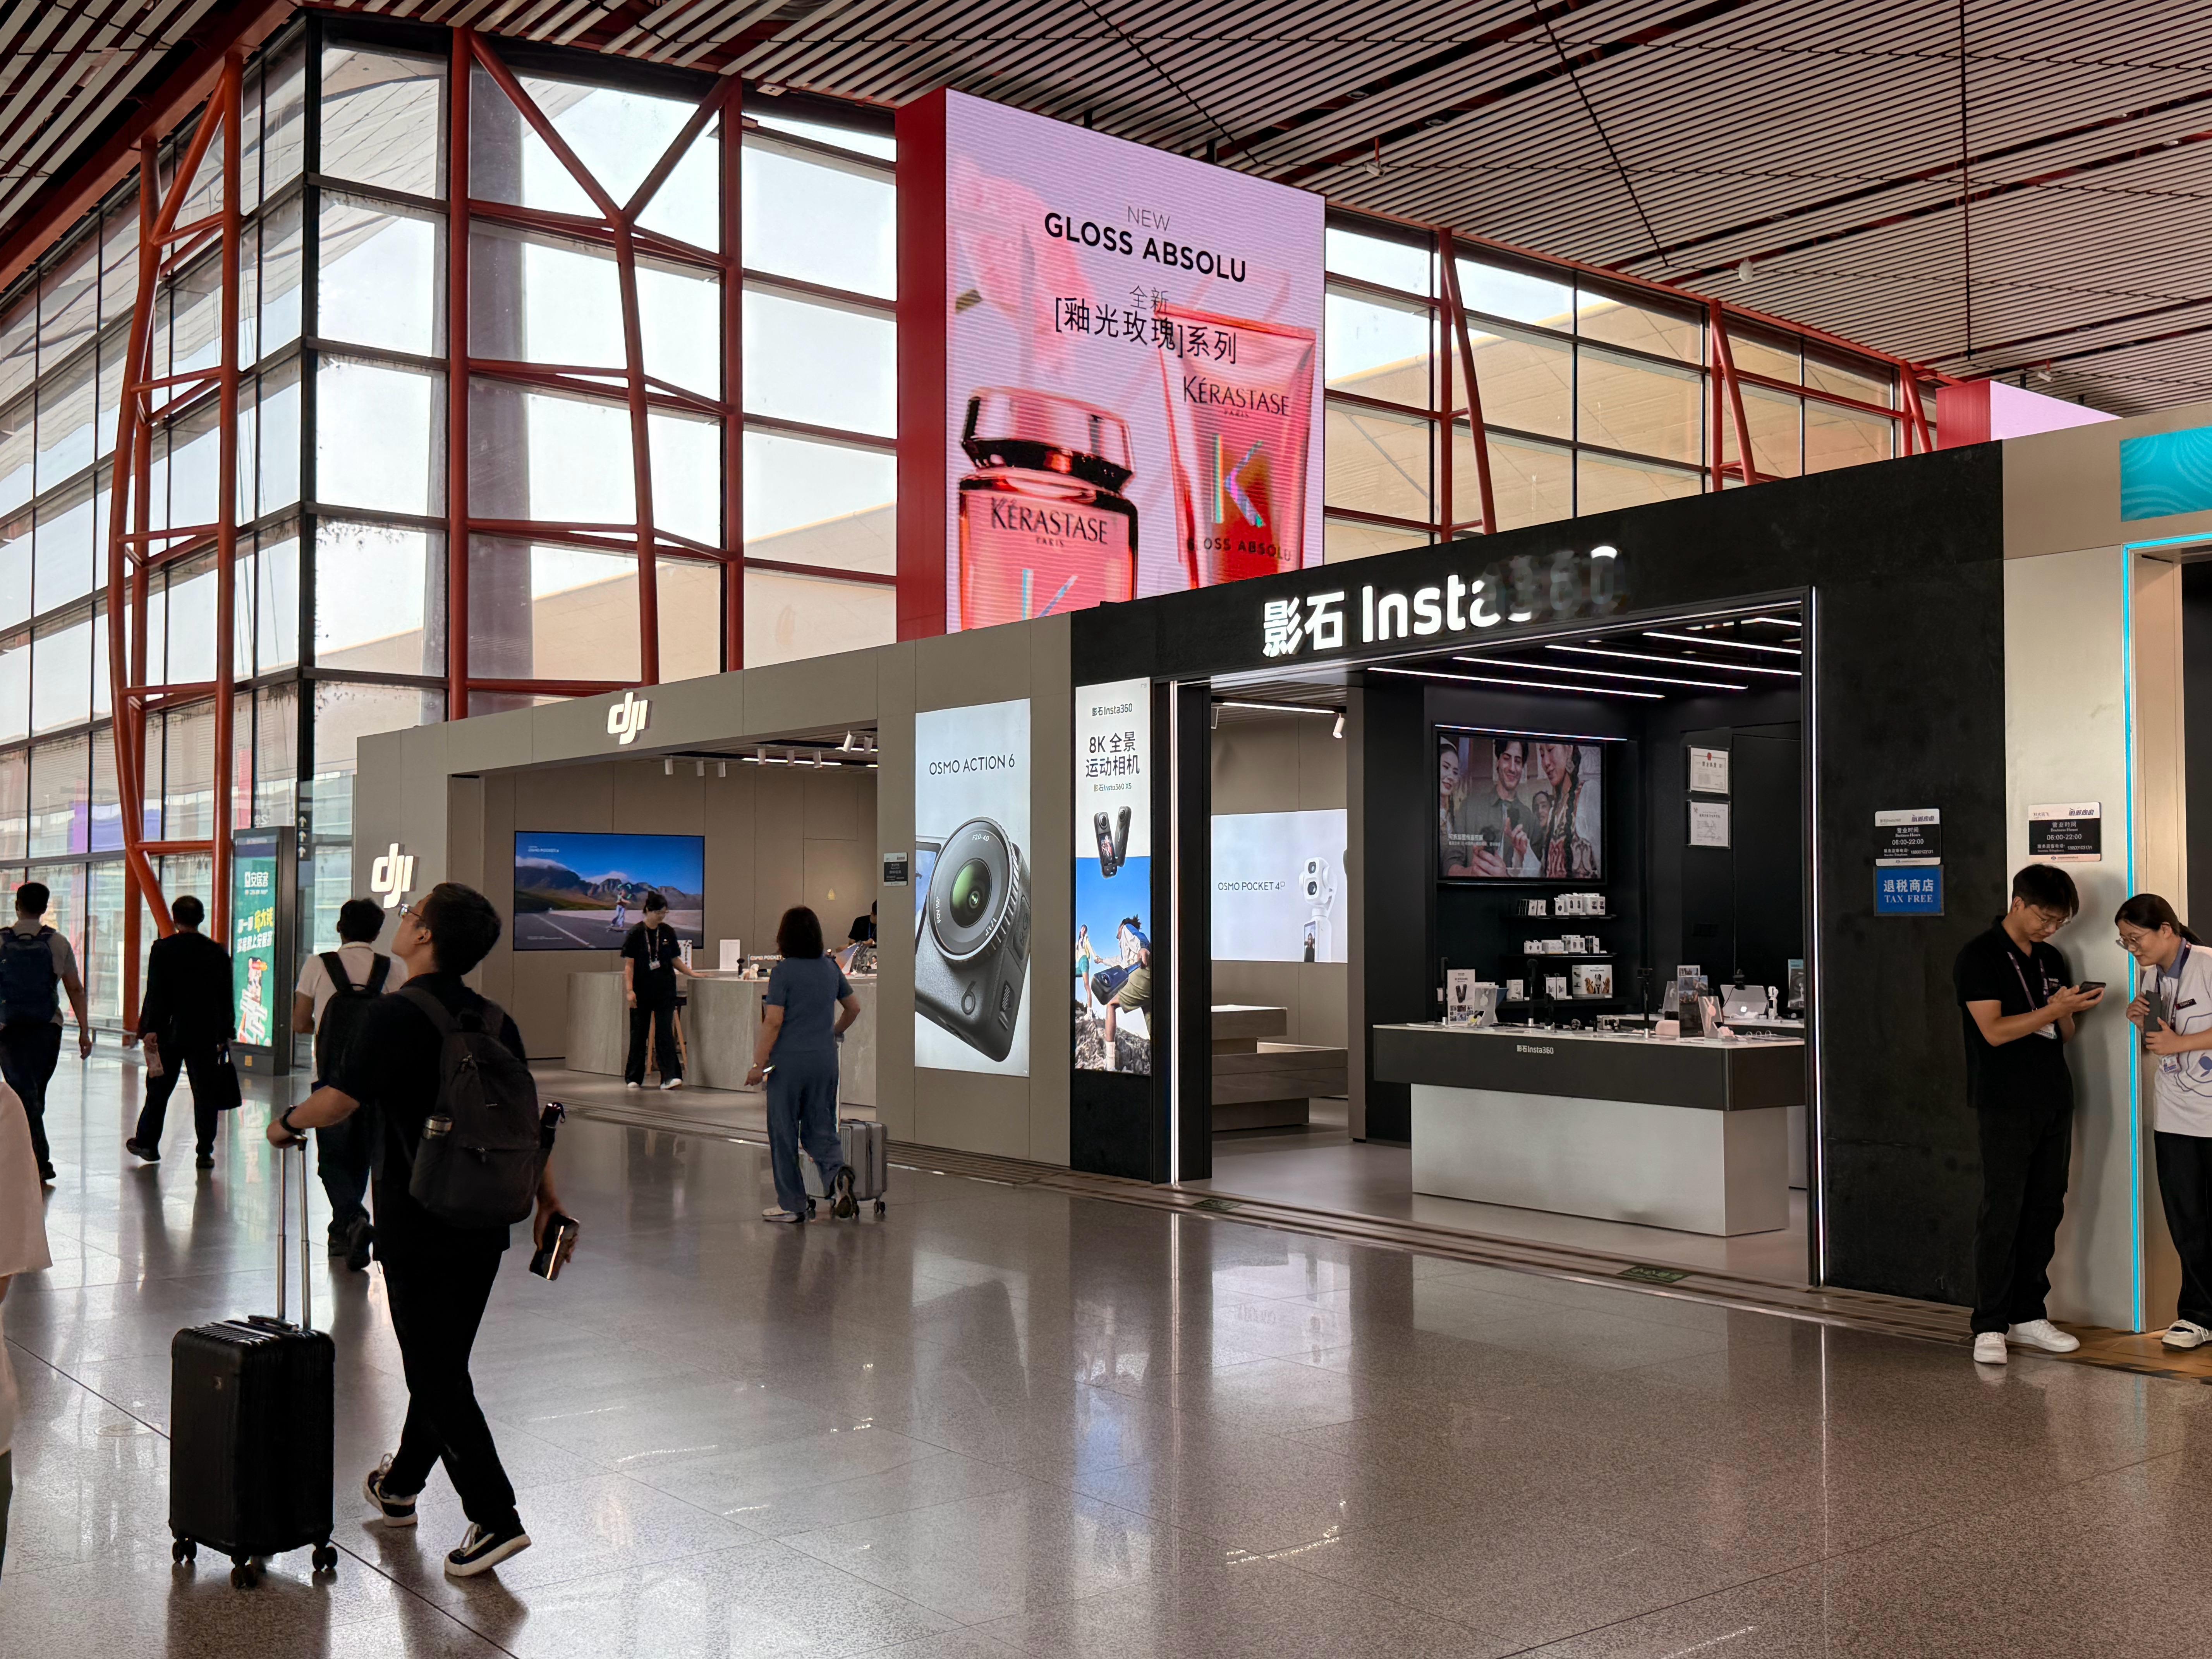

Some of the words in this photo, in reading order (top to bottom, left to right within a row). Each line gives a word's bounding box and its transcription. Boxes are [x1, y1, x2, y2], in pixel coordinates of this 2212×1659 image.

[1127, 206, 1170, 232] NEW
[1044, 212, 1133, 255] GLOSS
[1142, 237, 1246, 282] ABSOLU
[1129, 285, 1169, 312] 全新
[1056, 297, 1237, 364] [釉光玫瑰]系列
[1183, 375, 1291, 417] KÉRASTASE
[991, 497, 1108, 545] KÉRASTASE
[1036, 536, 1064, 547] PARIS
[1237, 541, 1291, 562] ABSOLU
[1262, 595, 1346, 658] 影石
[1089, 735, 1106, 753] 8K
[1109, 731, 1135, 753] 全景
[929, 759, 960, 775] OSMO
[963, 754, 1005, 773] ACTION
[1008, 754, 1015, 768] 6
[1086, 754, 1140, 778] 运动相机
[1218, 882, 1240, 891] OSMO
[1242, 881, 1274, 891] POCKET
[1275, 881, 1285, 891] 4P
[1883, 878, 1934, 892] 退税商店
[1884, 895, 1903, 903] TAX
[1908, 894, 1933, 903] FREE
[961, 980, 976, 1015] 6
